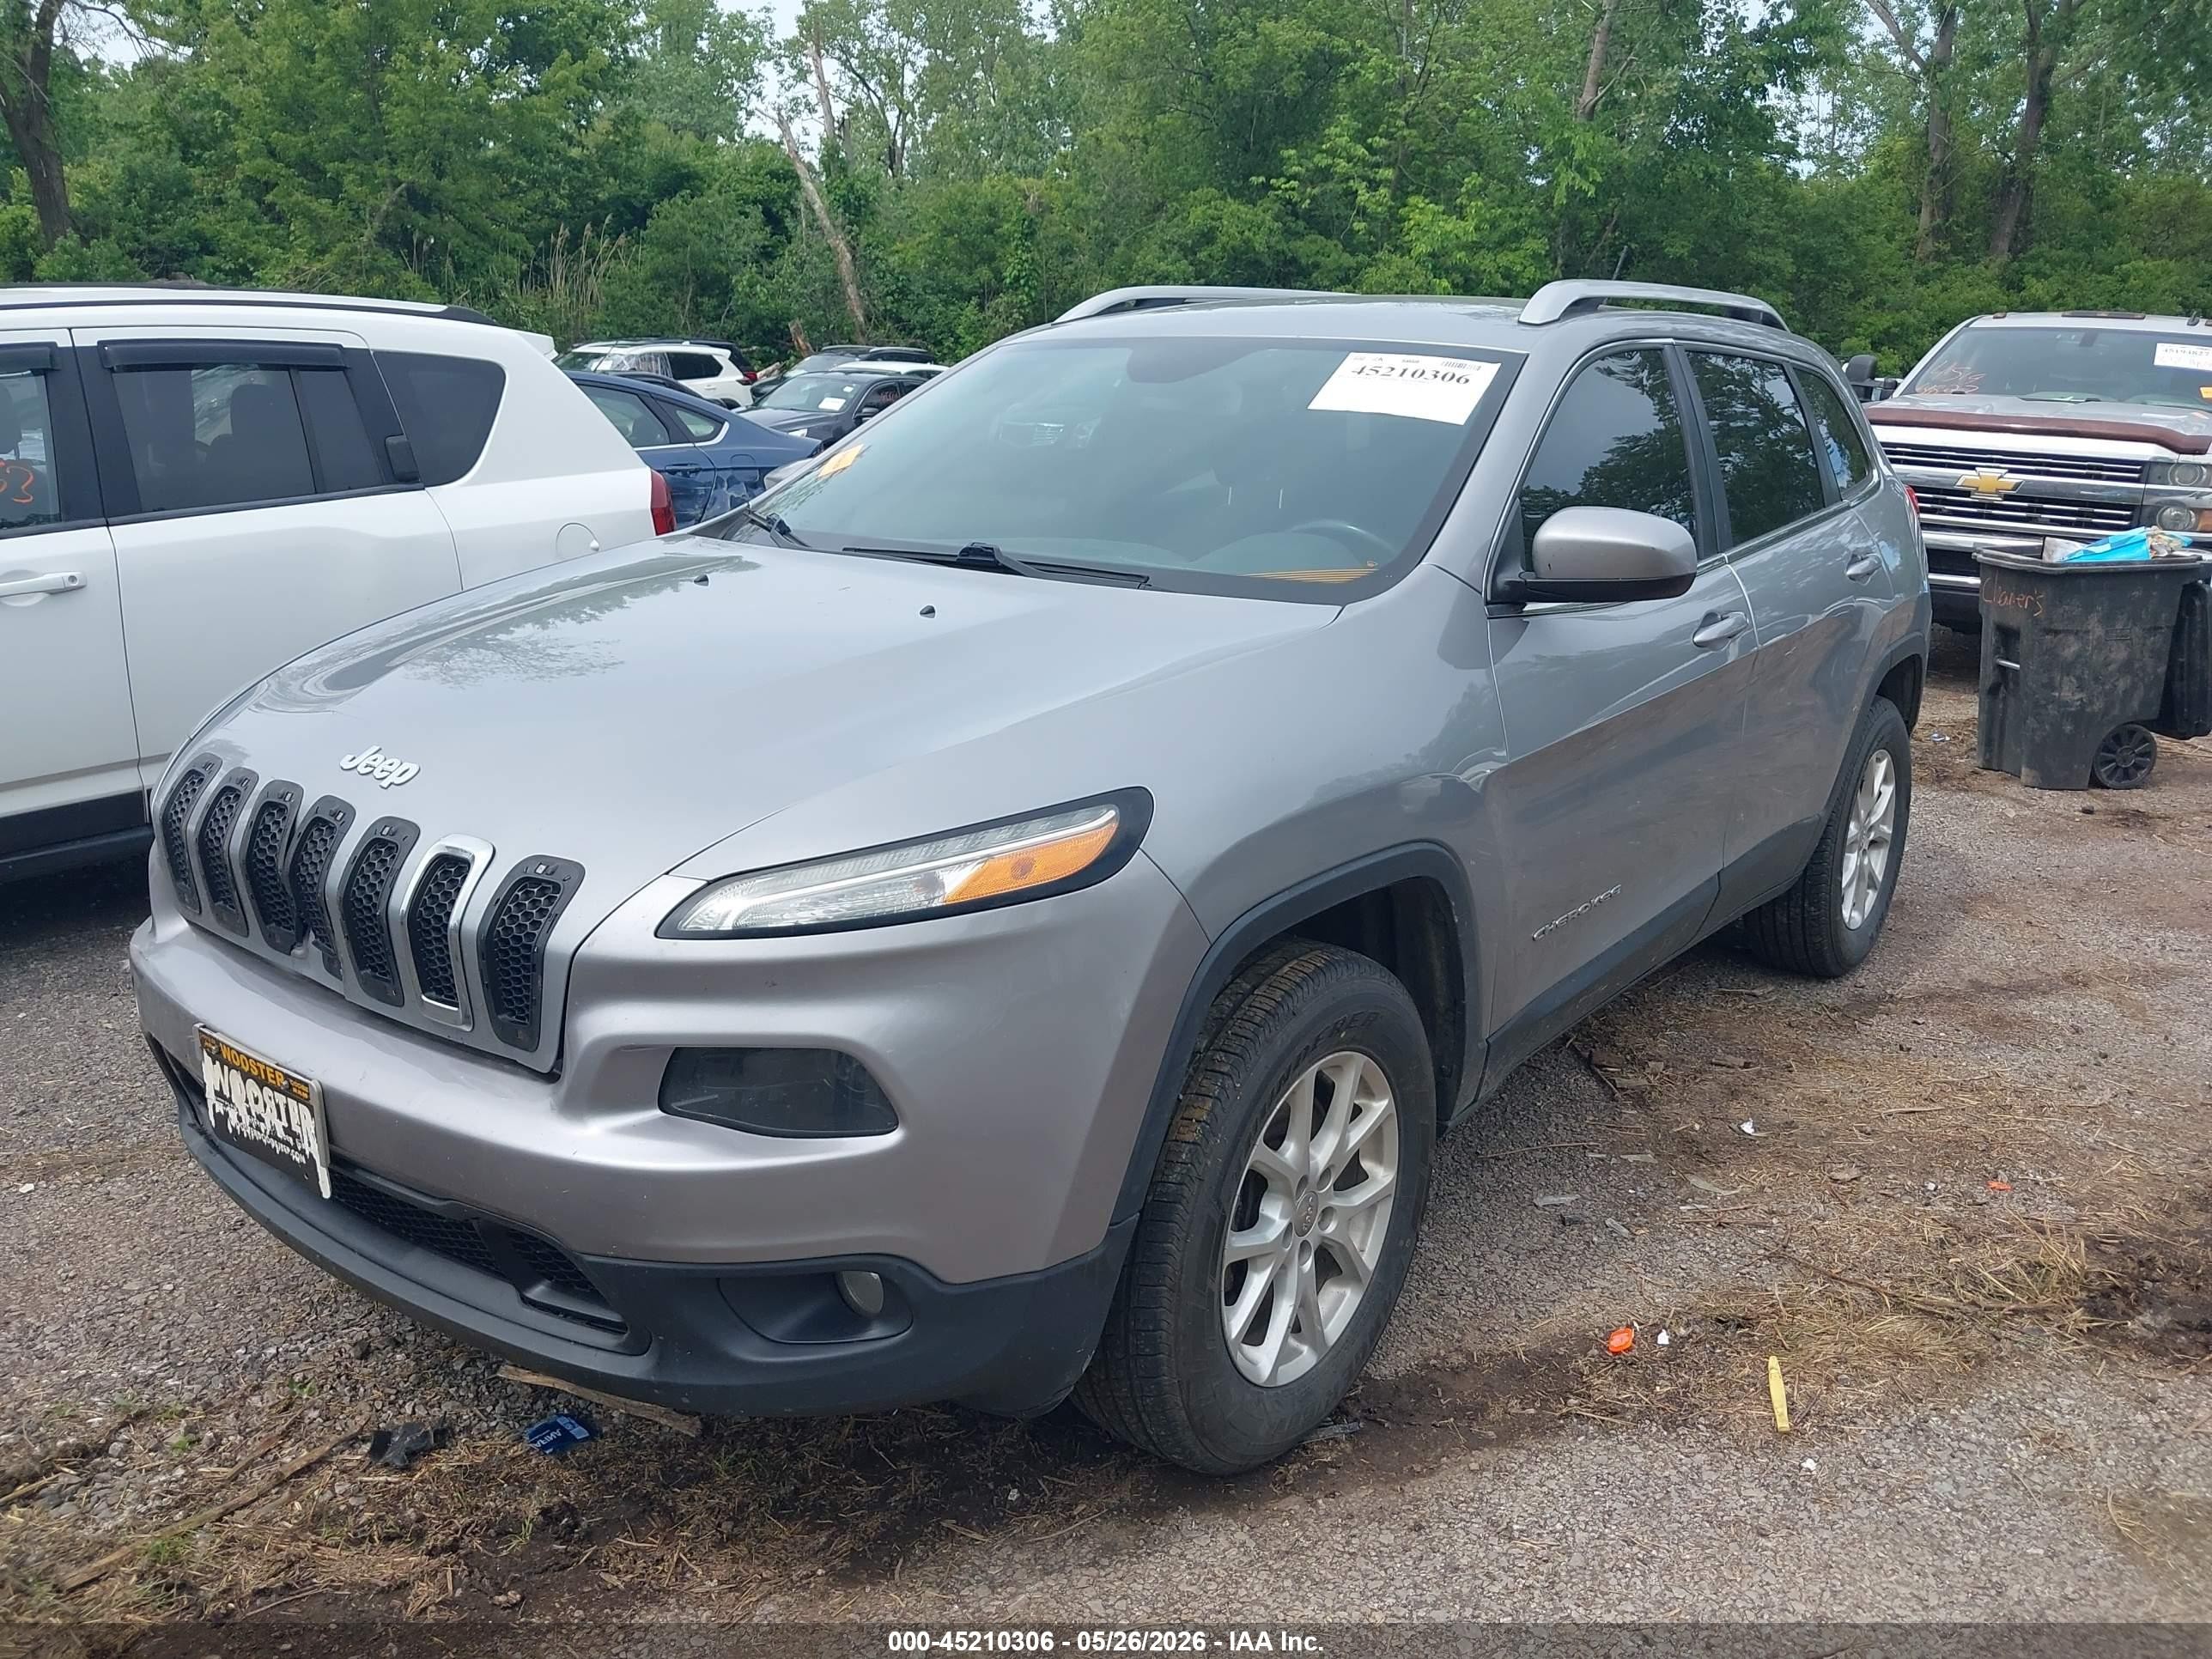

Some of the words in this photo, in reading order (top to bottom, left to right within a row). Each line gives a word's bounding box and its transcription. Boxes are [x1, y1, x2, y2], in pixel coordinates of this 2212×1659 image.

[1352, 365, 1471, 386] 45210306
[339, 744, 421, 790] Jeep
[1532, 884, 1622, 941] CHEROKEE
[220, 1042, 285, 1087] WOOSTER
